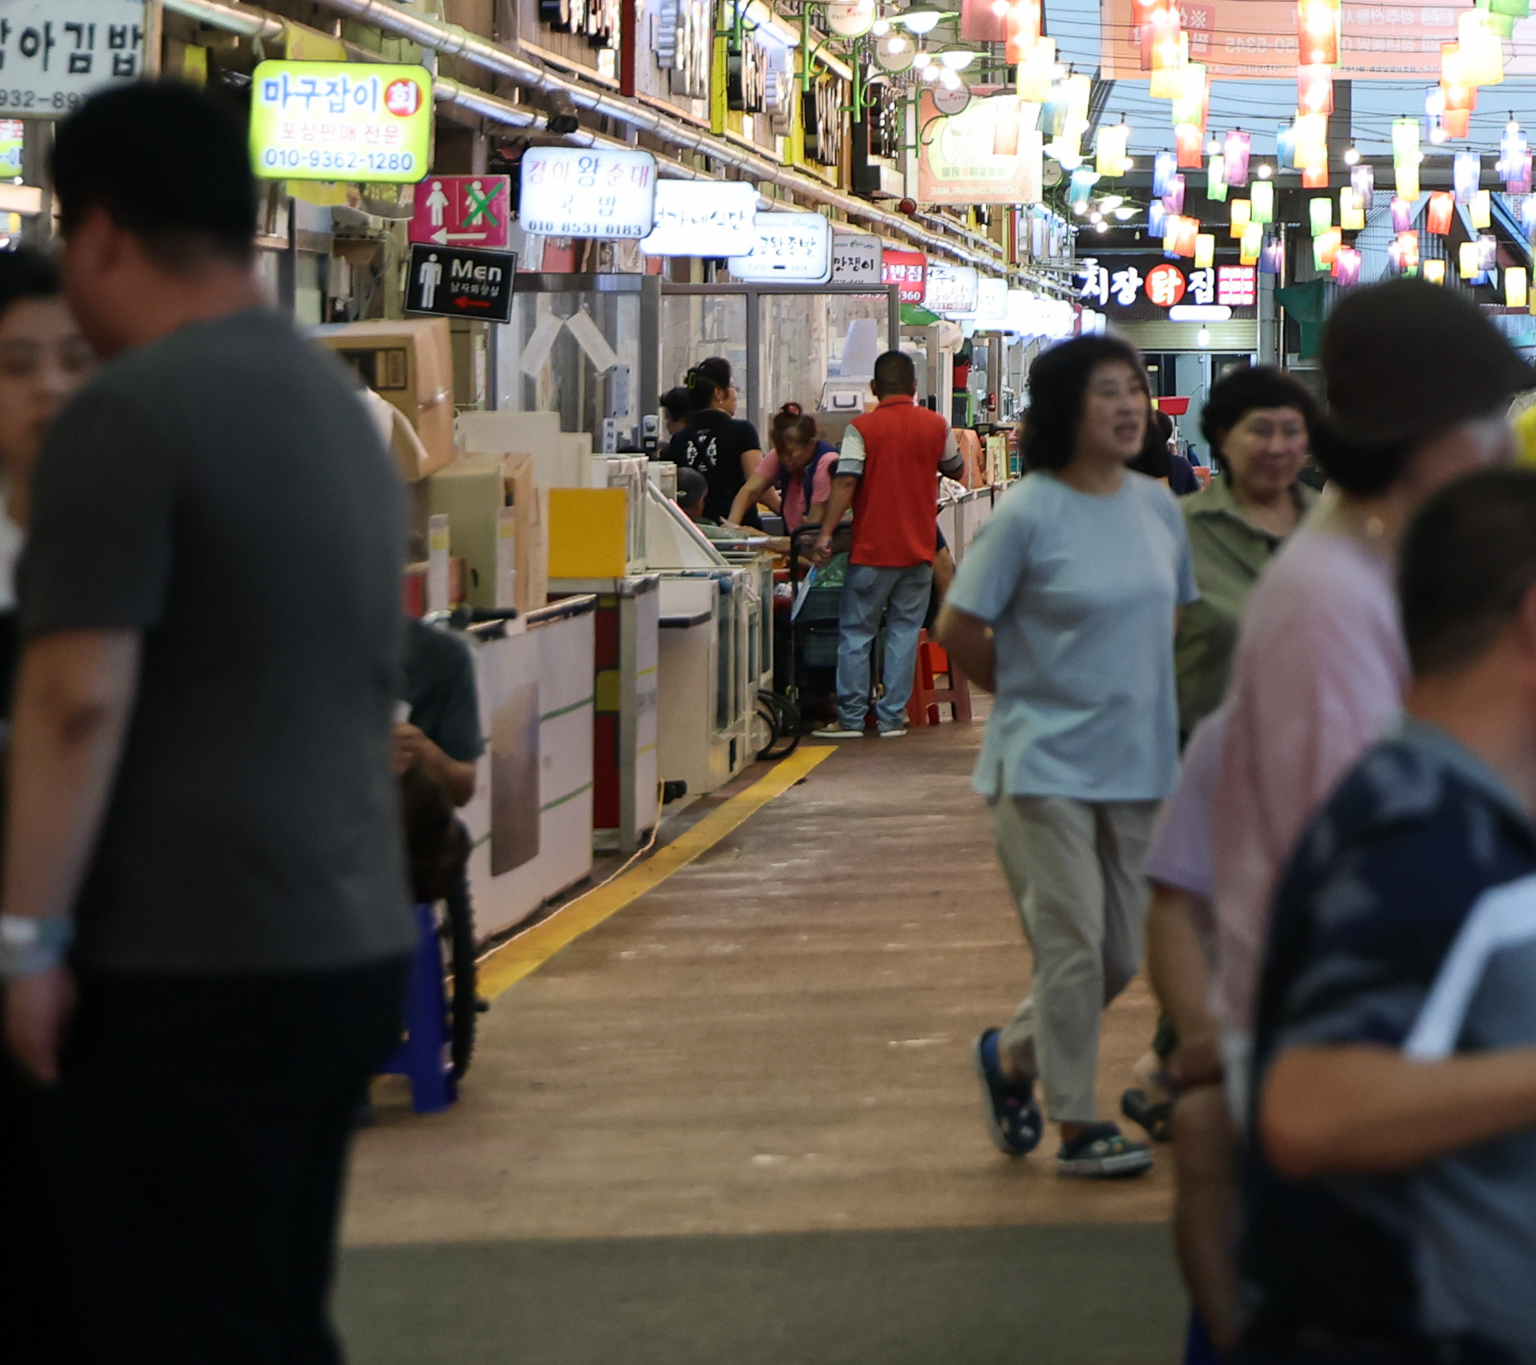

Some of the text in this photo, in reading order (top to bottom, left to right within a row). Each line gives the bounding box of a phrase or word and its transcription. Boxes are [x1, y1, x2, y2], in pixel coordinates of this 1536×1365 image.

[264, 73, 418, 115] 마구잡이 회
[363, 124, 401, 145] 전문
[264, 147, 414, 171] 010-9362-1280
[451, 258, 502, 282] Men
